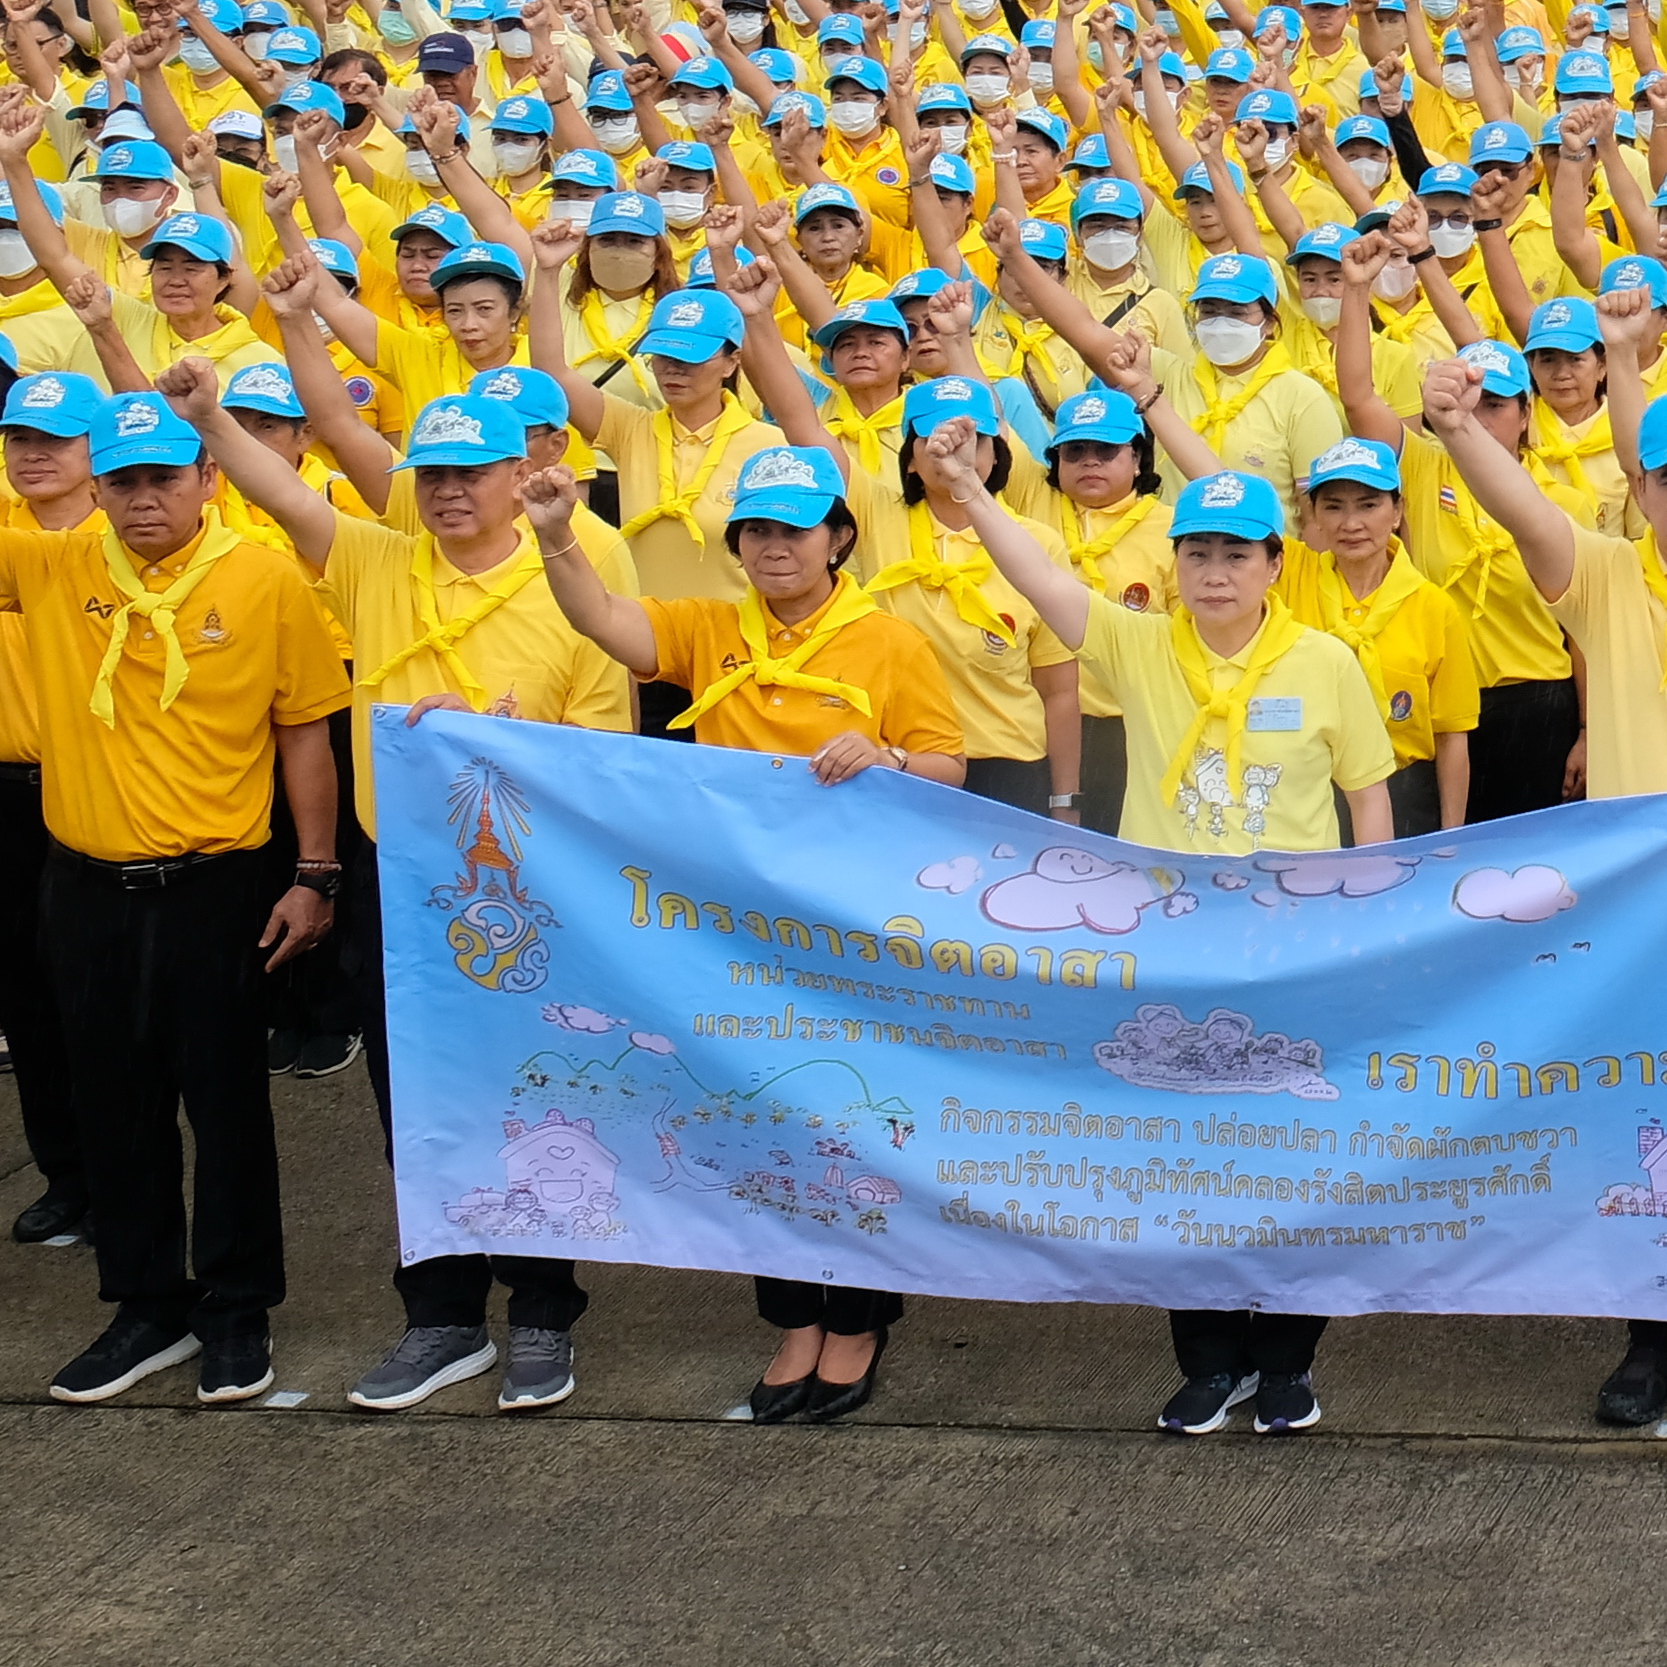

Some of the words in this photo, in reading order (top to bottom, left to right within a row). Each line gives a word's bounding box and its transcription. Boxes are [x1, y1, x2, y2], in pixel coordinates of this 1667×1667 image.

[618, 865, 1138, 991] โครงการจิตอาสา
[727, 955, 1032, 1022] หน่วยพระราชทาน
[692, 1002, 1068, 1061] และประชาชนจิตอาสา
[939, 1097, 1182, 1144] กิจกรรมจิตอาสา
[1191, 1098, 1337, 1156] ปล่อยปลา
[1347, 1119, 1579, 1162] กำจัดผักตบชวา
[939, 1197, 1143, 1245] เนื่องในโอกาส
[1154, 1212, 1485, 1250] “วันนวมินทรมหาราช”
